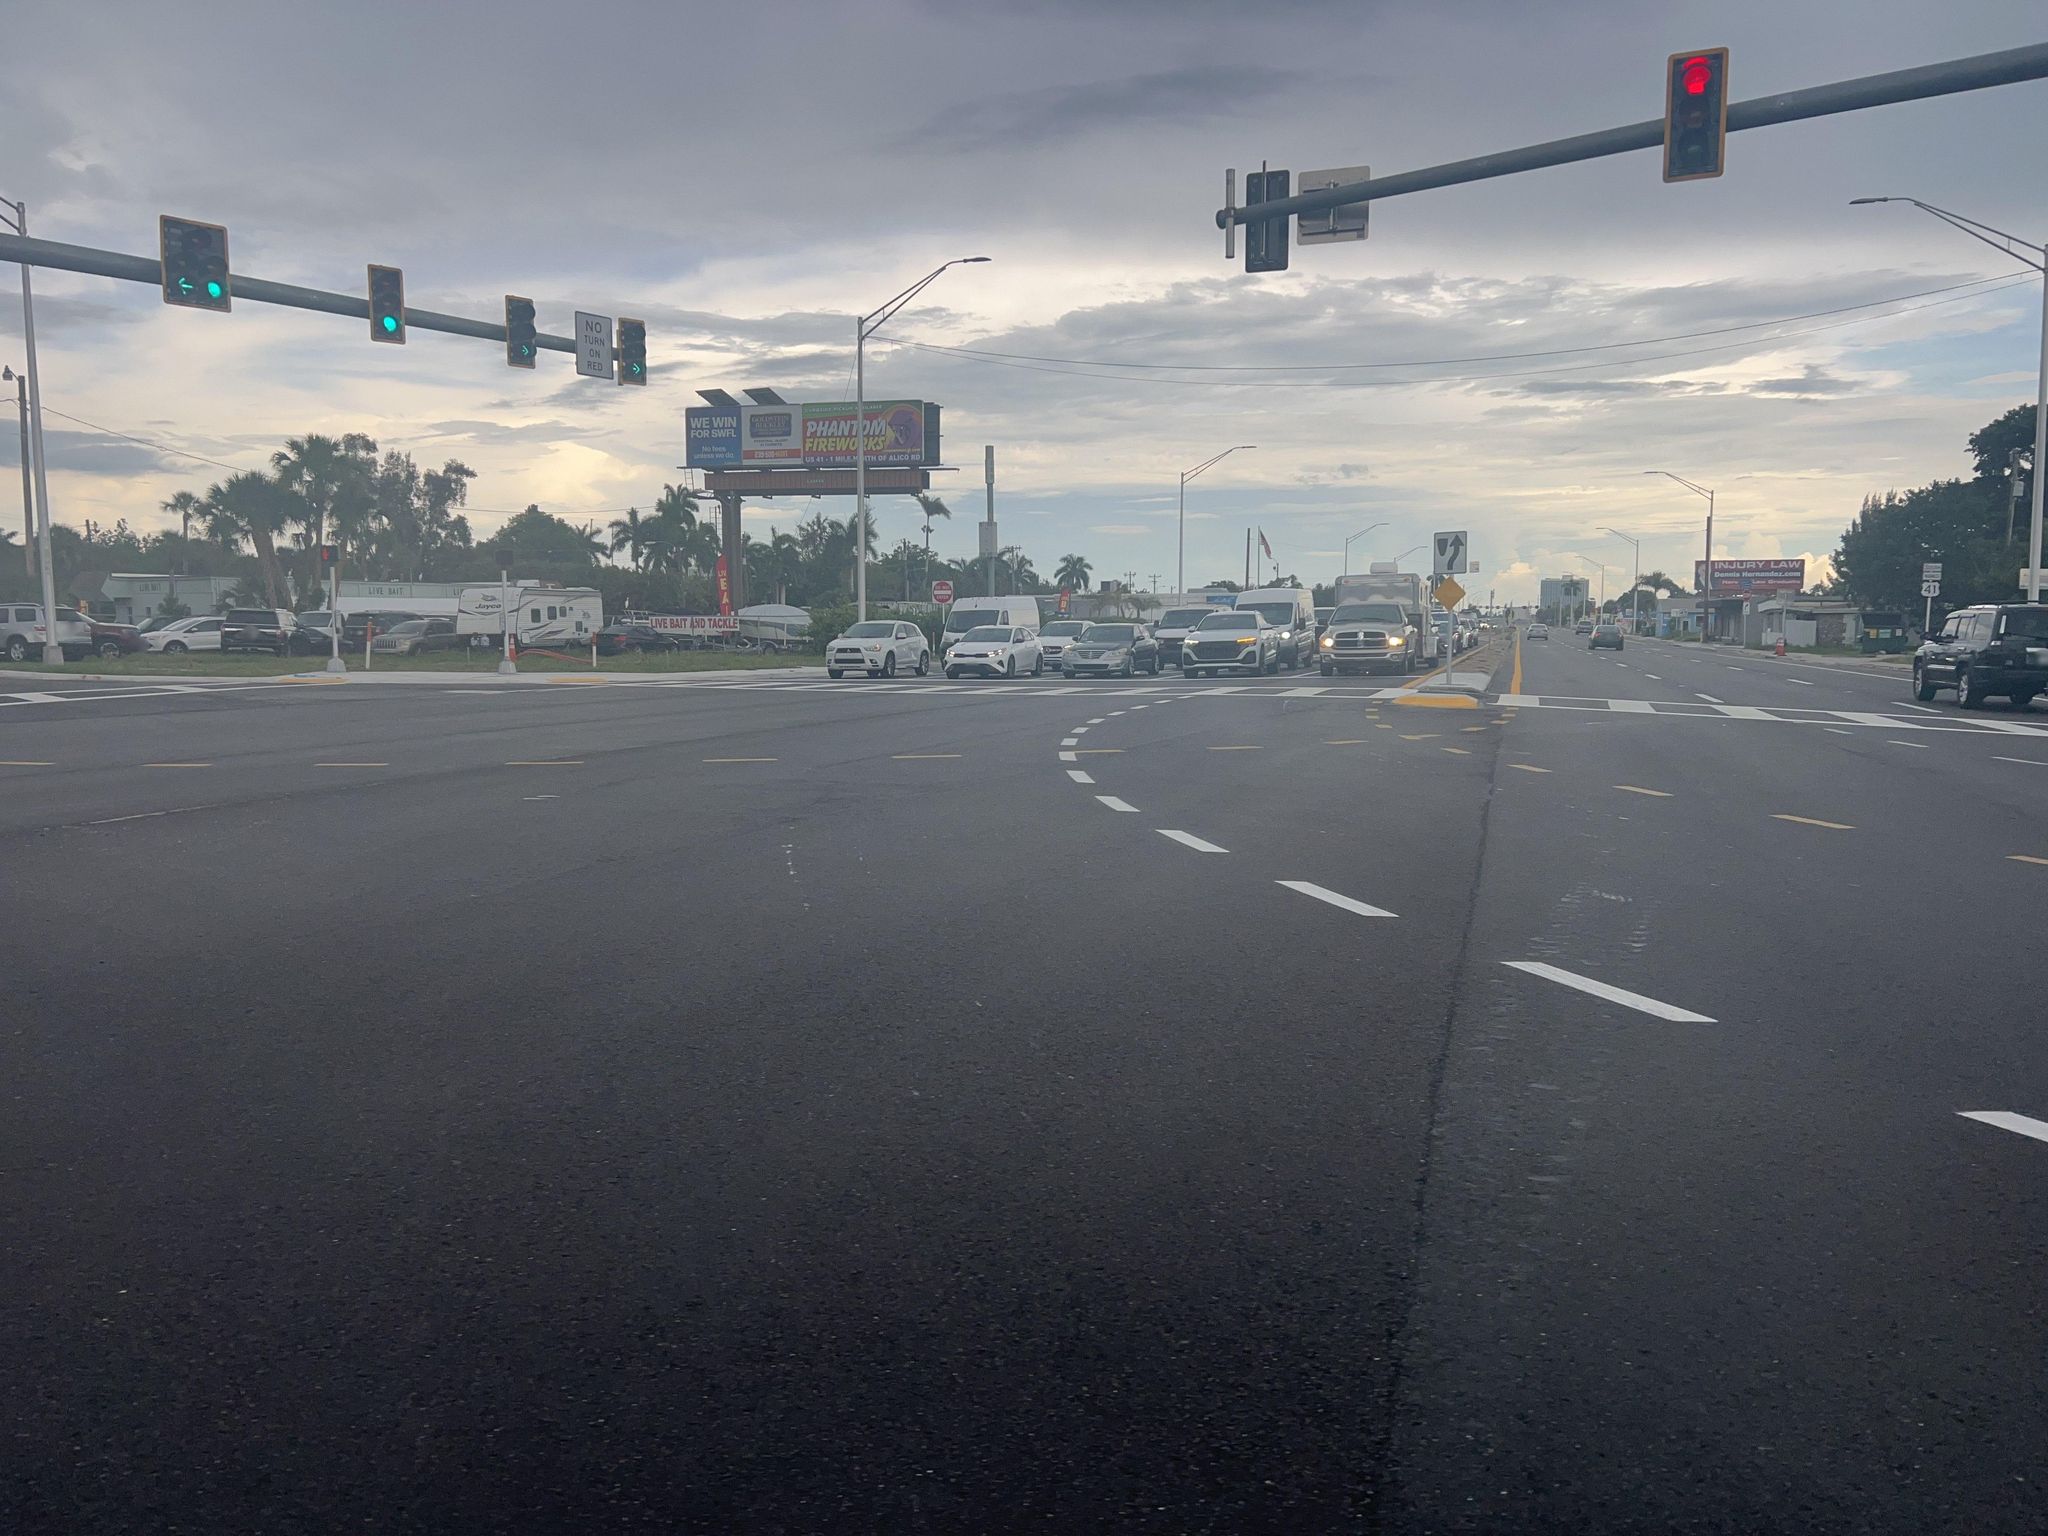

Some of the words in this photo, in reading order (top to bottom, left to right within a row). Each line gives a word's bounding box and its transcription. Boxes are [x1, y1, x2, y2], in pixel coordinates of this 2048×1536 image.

[585, 320, 602, 334] NO
[584, 335, 605, 347] TURN
[589, 348, 601, 359] ON
[587, 361, 603, 371] RED
[690, 418, 710, 429] WE
[712, 416, 737, 428] WIN
[690, 429, 710, 438] FOR
[711, 428, 737, 438] SWFL
[806, 420, 886, 437] PHANTOM
[805, 436, 886, 452] FIREWORKS
[1714, 561, 1765, 569] INJURY
[368, 587, 384, 595] LIVE
[388, 587, 403, 595] BAIT
[1923, 584, 1937, 594] 41
[650, 618, 668, 629] LIVE
[669, 618, 688, 629] BAIT
[690, 618, 706, 629] AND
[707, 618, 738, 629] TACKLE
